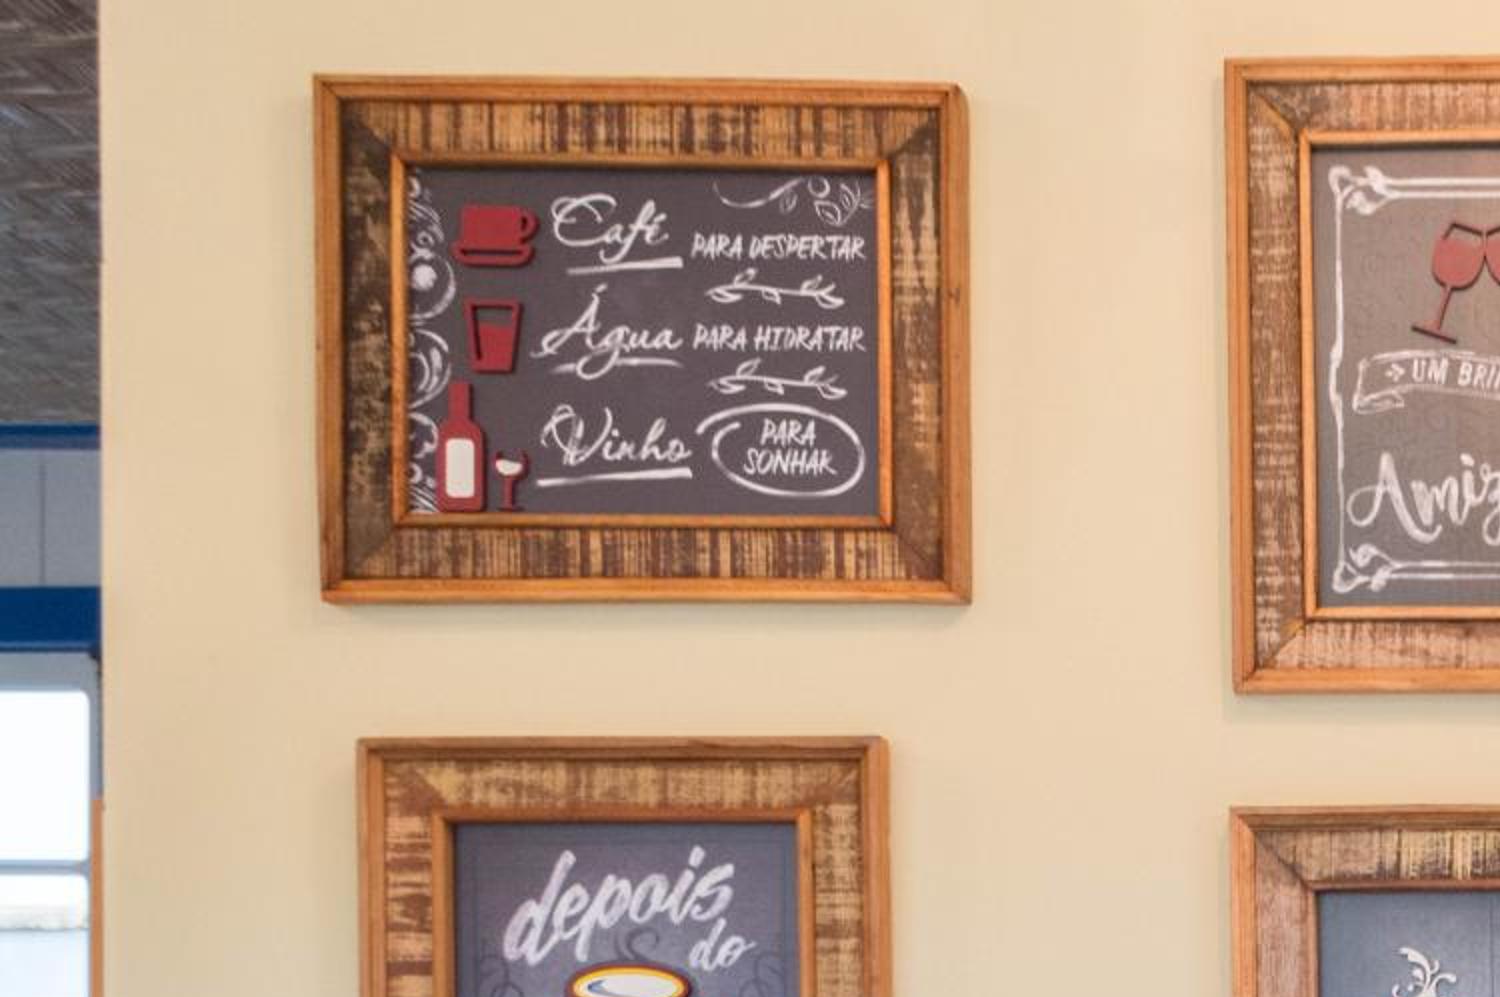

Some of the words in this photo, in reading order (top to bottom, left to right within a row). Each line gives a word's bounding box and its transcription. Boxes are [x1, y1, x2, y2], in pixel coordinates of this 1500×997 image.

[551, 193, 670, 263] Café
[691, 232, 743, 261] PARA
[750, 232, 867, 262] DESPERTAR
[531, 284, 683, 380] Água
[692, 323, 747, 352] PARA
[754, 324, 867, 352] HIDRATAR
[1411, 358, 1449, 385] UM
[540, 404, 692, 466] Vinho
[760, 418, 816, 447] PARA
[743, 447, 837, 477] SONHAR
[503, 846, 734, 966] depois
[689, 919, 757, 970] do
